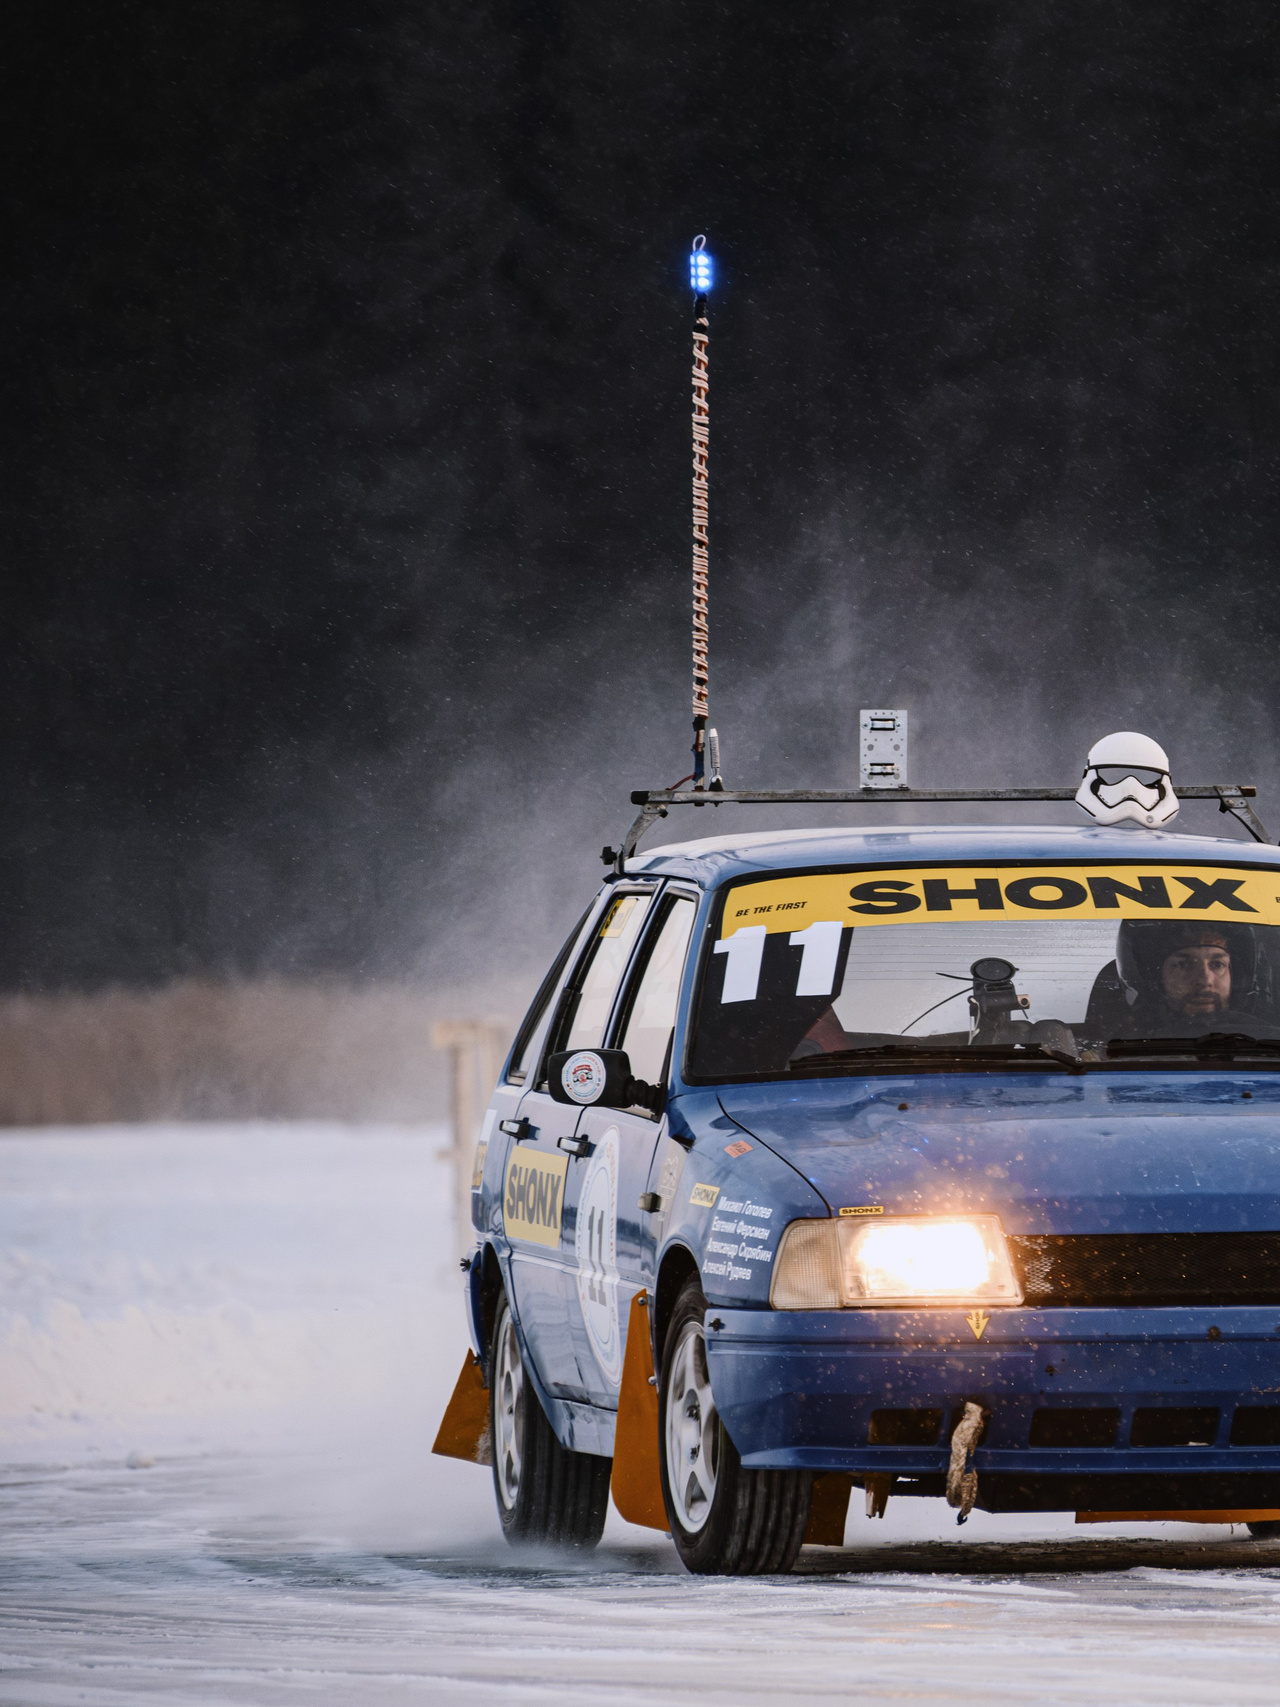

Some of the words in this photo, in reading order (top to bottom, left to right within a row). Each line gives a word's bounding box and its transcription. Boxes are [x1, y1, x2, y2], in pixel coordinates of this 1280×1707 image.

[735, 909, 750, 917] BE
[753, 905, 773, 914] THE
[776, 901, 808, 911] FIRST
[847, 876, 1260, 915] SHONX
[713, 921, 844, 1005] 11
[506, 1164, 562, 1229] SHONX
[841, 1207, 882, 1215] SHONX
